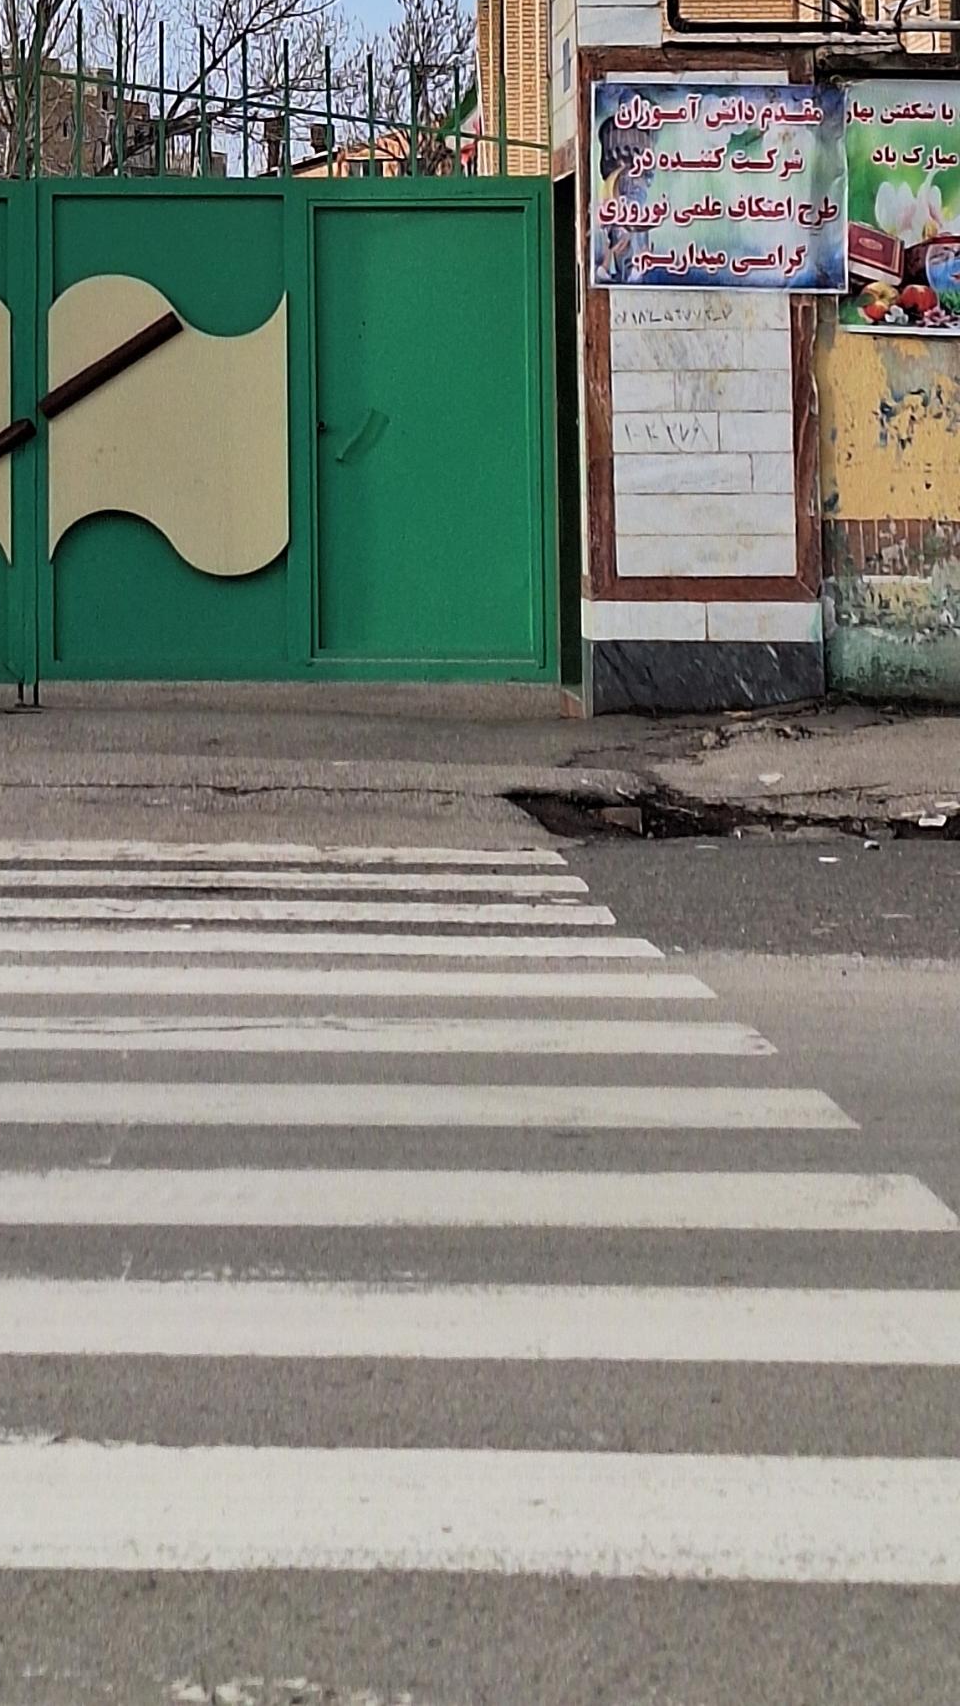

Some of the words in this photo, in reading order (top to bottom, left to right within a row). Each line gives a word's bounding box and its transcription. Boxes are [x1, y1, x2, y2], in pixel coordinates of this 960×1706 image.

[614, 93, 701, 130] آموزان
[705, 96, 756, 129] دانش
[759, 97, 824, 130] مقدم
[846, 100, 874, 124] بهار
[880, 101, 936, 125] شکفتن
[941, 102, 954, 126] با
[629, 149, 655, 178] در
[658, 147, 726, 170] کننده
[730, 148, 804, 181] شرکت
[873, 144, 897, 169] باد
[902, 146, 958, 171] مبارک
[598, 194, 669, 226] نوروزی
[672, 196, 723, 226] علمی
[727, 196, 793, 221] اعتکاف
[797, 196, 839, 228] طرح
[731, 245, 807, 278] گرامی
